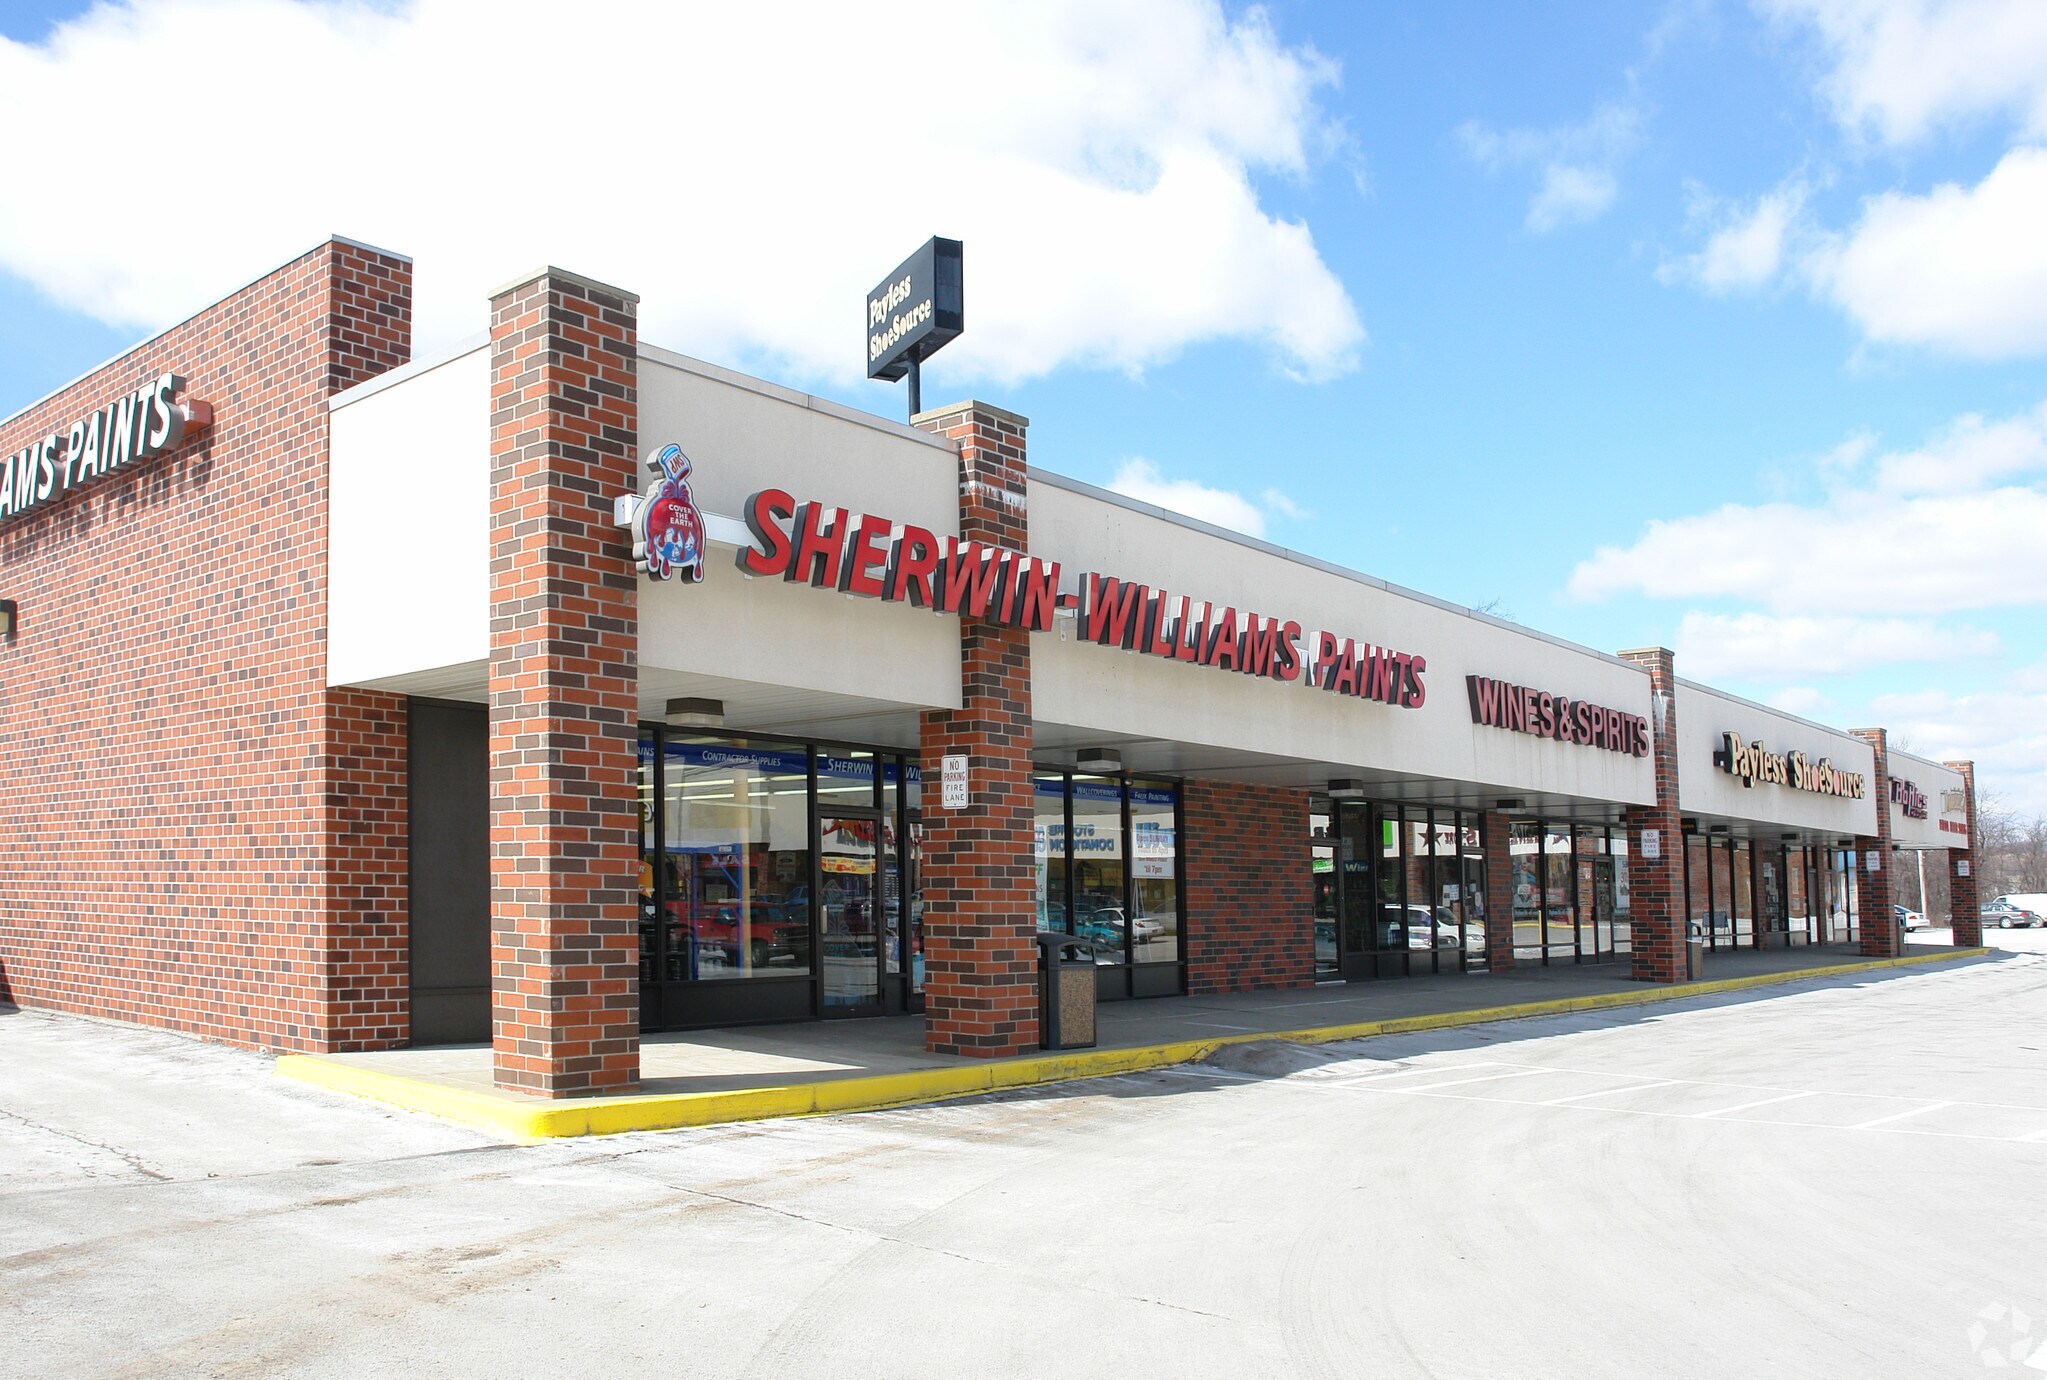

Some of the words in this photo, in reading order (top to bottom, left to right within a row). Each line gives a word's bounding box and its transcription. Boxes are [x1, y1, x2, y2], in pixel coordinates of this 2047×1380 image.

[869, 275, 911, 329] Payless
[870, 299, 932, 361] ShoeSource
[63, 371, 178, 490] PAINTS
[668, 503, 692, 514] COVER
[670, 517, 693, 528] EARTH
[674, 511, 689, 519] THE
[1308, 630, 1426, 709] PAINTS
[1467, 675, 1555, 738] WINES
[1556, 696, 1574, 741] &
[1573, 700, 1650, 758] SPIRITS
[750, 756, 781, 767] SUPPLIES
[944, 772, 966, 782] PARKING
[949, 760, 960, 770] NO
[1728, 731, 1788, 789] Payless
[1790, 750, 1866, 799] ShoeSource
